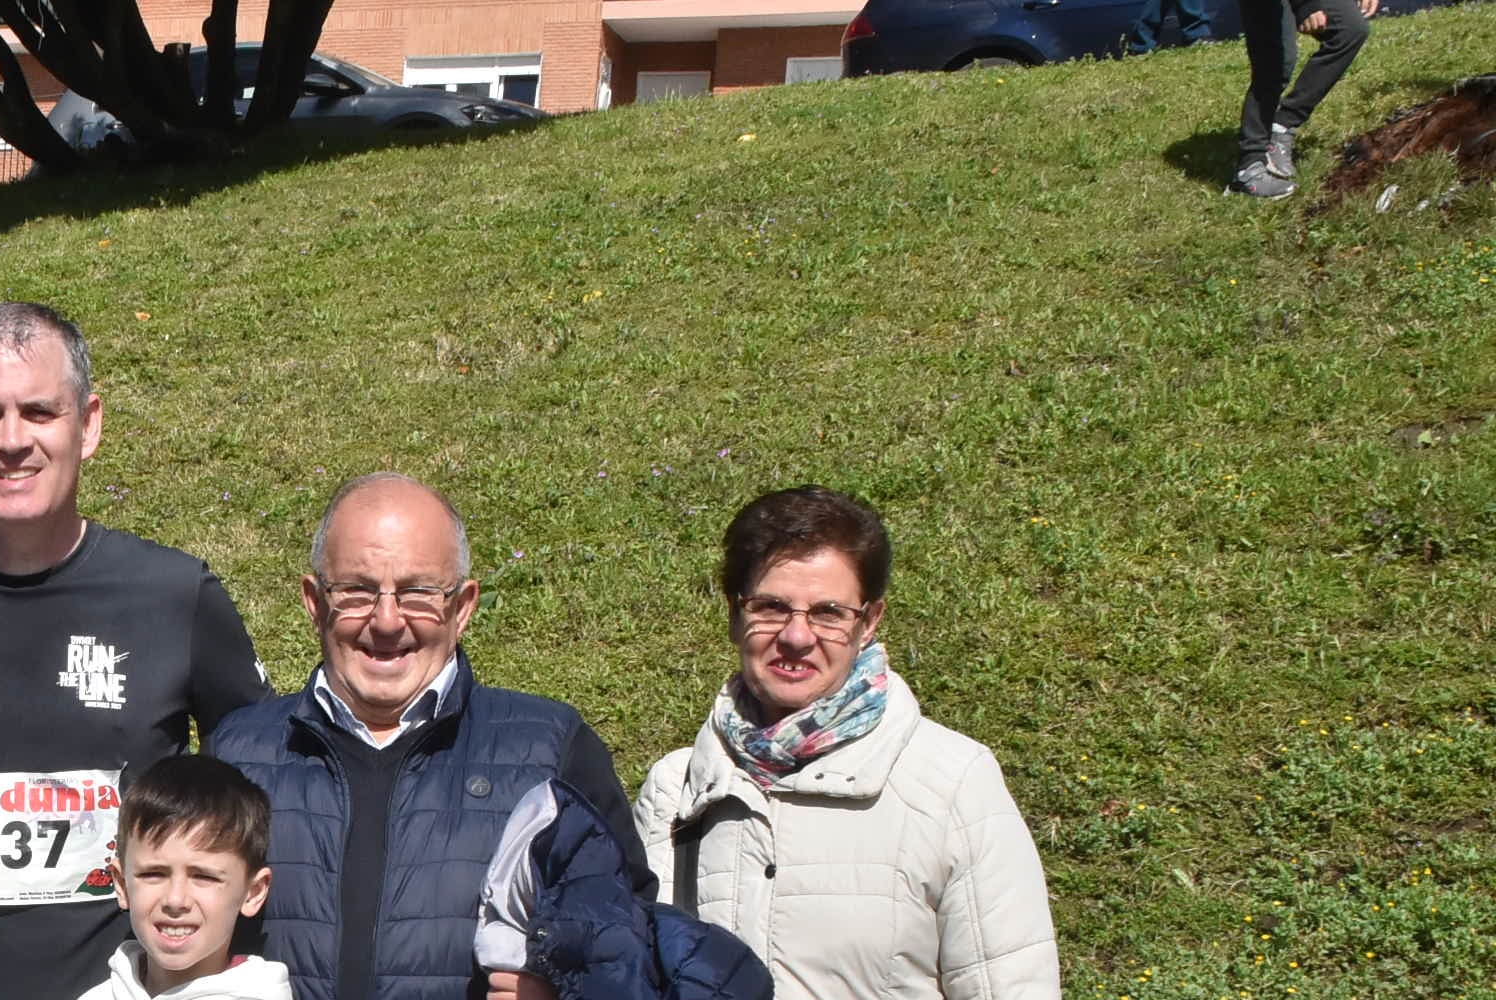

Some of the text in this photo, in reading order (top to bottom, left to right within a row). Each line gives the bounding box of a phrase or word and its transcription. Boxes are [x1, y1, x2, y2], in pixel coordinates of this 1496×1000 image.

[67, 644, 115, 673] RUN
[58, 671, 126, 703] THE LINE
[0, 819, 71, 870] 37
